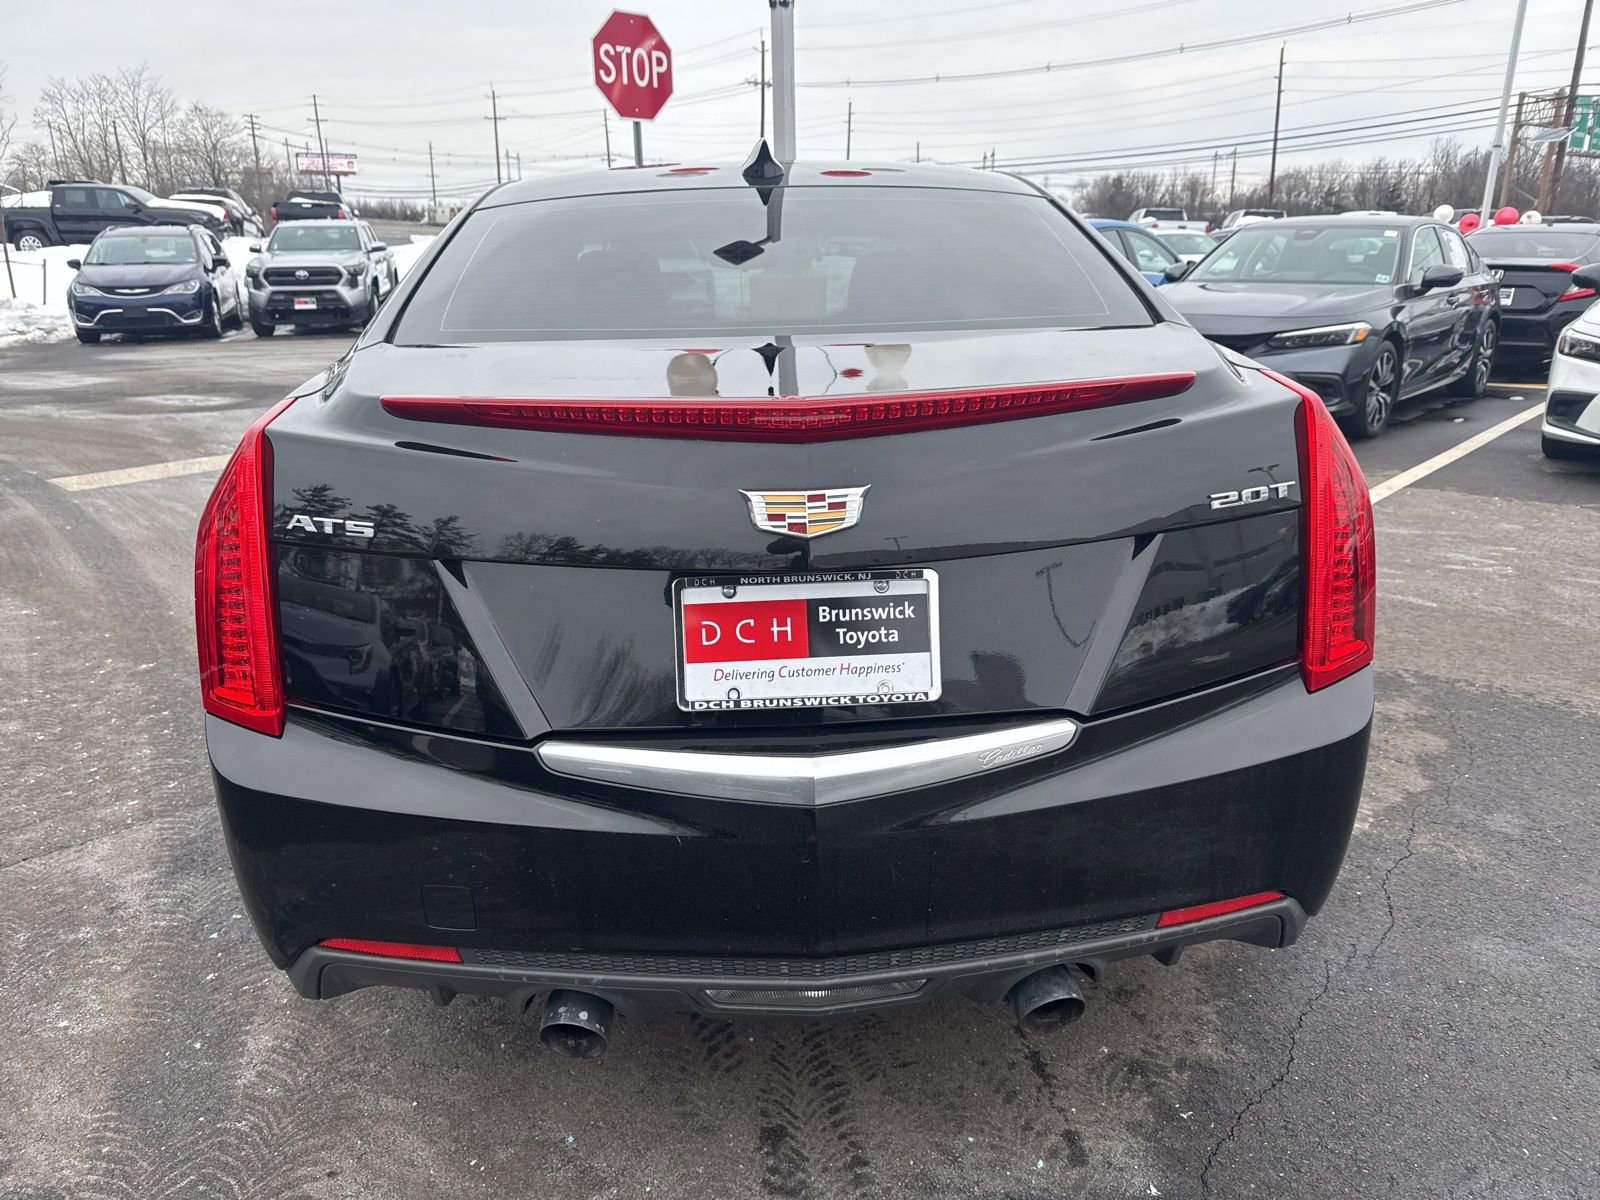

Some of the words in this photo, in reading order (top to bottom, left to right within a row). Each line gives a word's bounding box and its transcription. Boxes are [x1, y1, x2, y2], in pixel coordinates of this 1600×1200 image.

[598, 42, 668, 88] STOP
[285, 514, 375, 538] ATS
[740, 575, 781, 585] NORTH
[858, 571, 872, 581] NJ
[818, 601, 916, 623] Brunswick
[835, 626, 899, 649] Toyota
[713, 667, 776, 683] Delivering
[778, 665, 837, 678] Customer
[694, 700, 735, 710] DCH
[740, 695, 852, 709] BRUNSWICK
[855, 692, 928, 704] TOYOTA
[978, 743, 1043, 769] Cadillac
